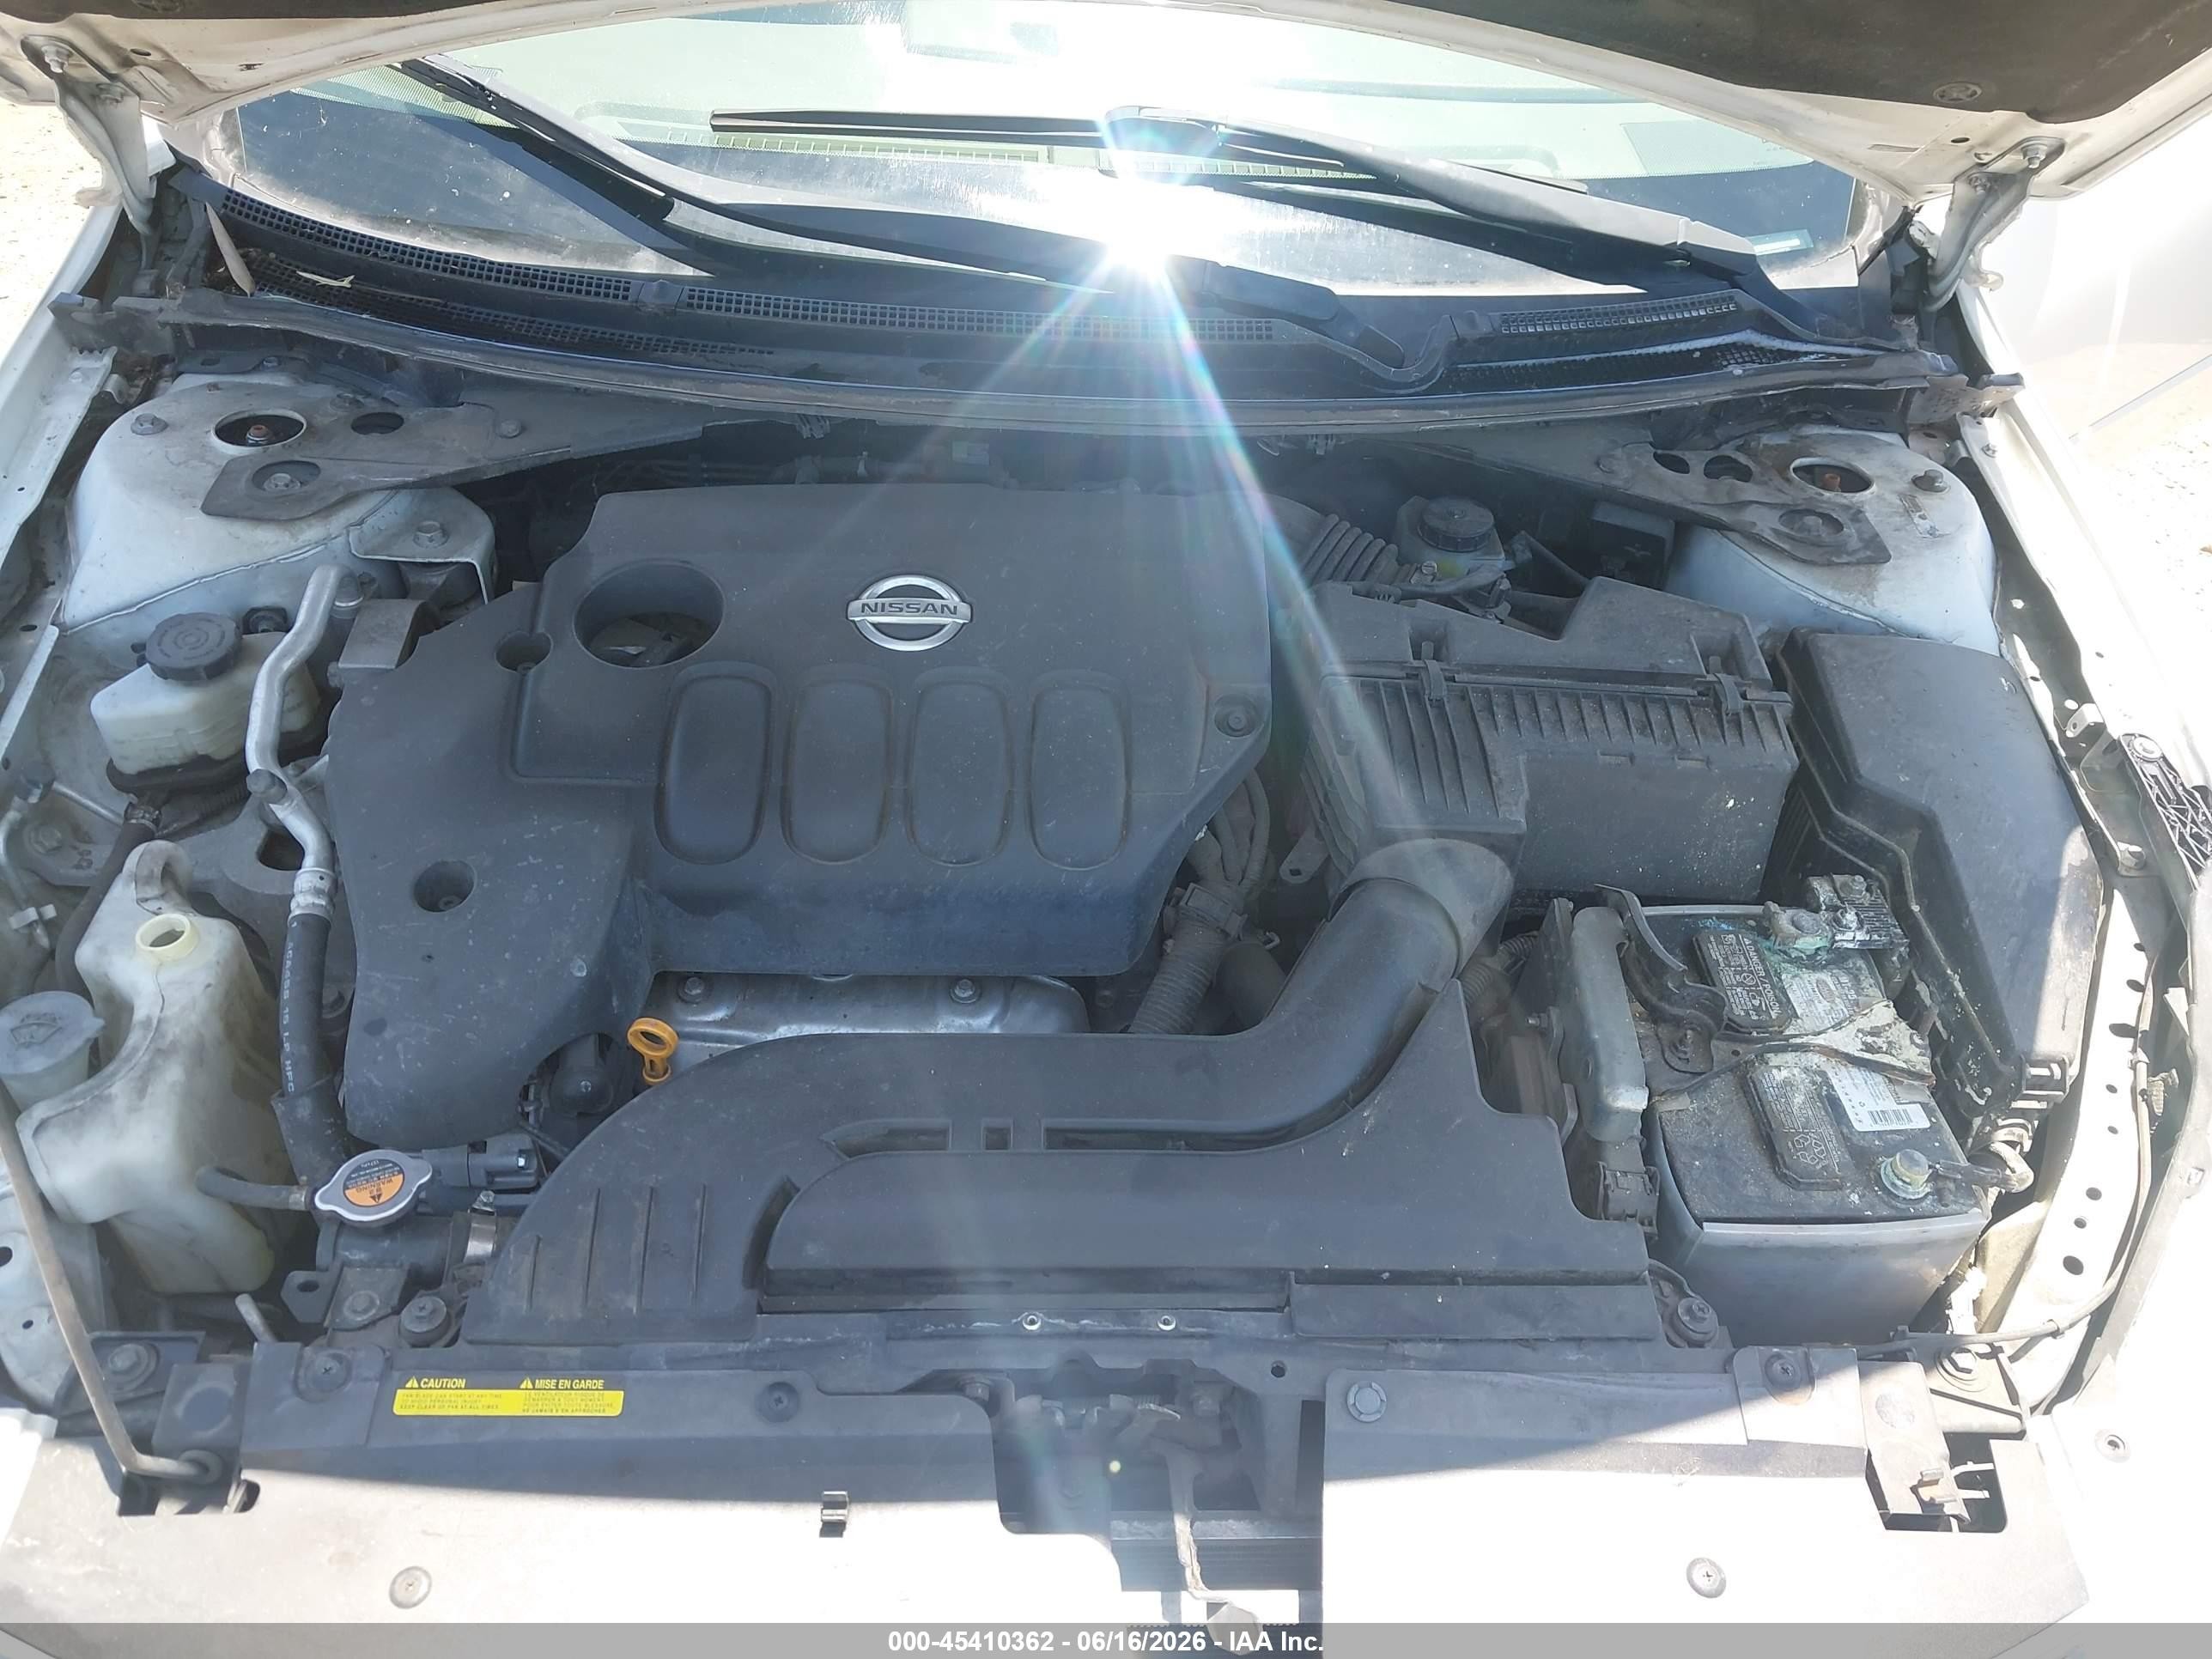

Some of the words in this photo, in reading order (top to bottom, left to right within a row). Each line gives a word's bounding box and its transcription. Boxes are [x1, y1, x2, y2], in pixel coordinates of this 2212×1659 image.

[860, 602, 958, 616] NISSAN
[1746, 945, 1765, 976] DANGER
[1761, 983, 1783, 1015] POISON
[420, 1377, 466, 1389] CAUTION
[534, 1379, 557, 1389] MISE
[558, 1379, 571, 1389] EN
[572, 1379, 605, 1389] GARDE
